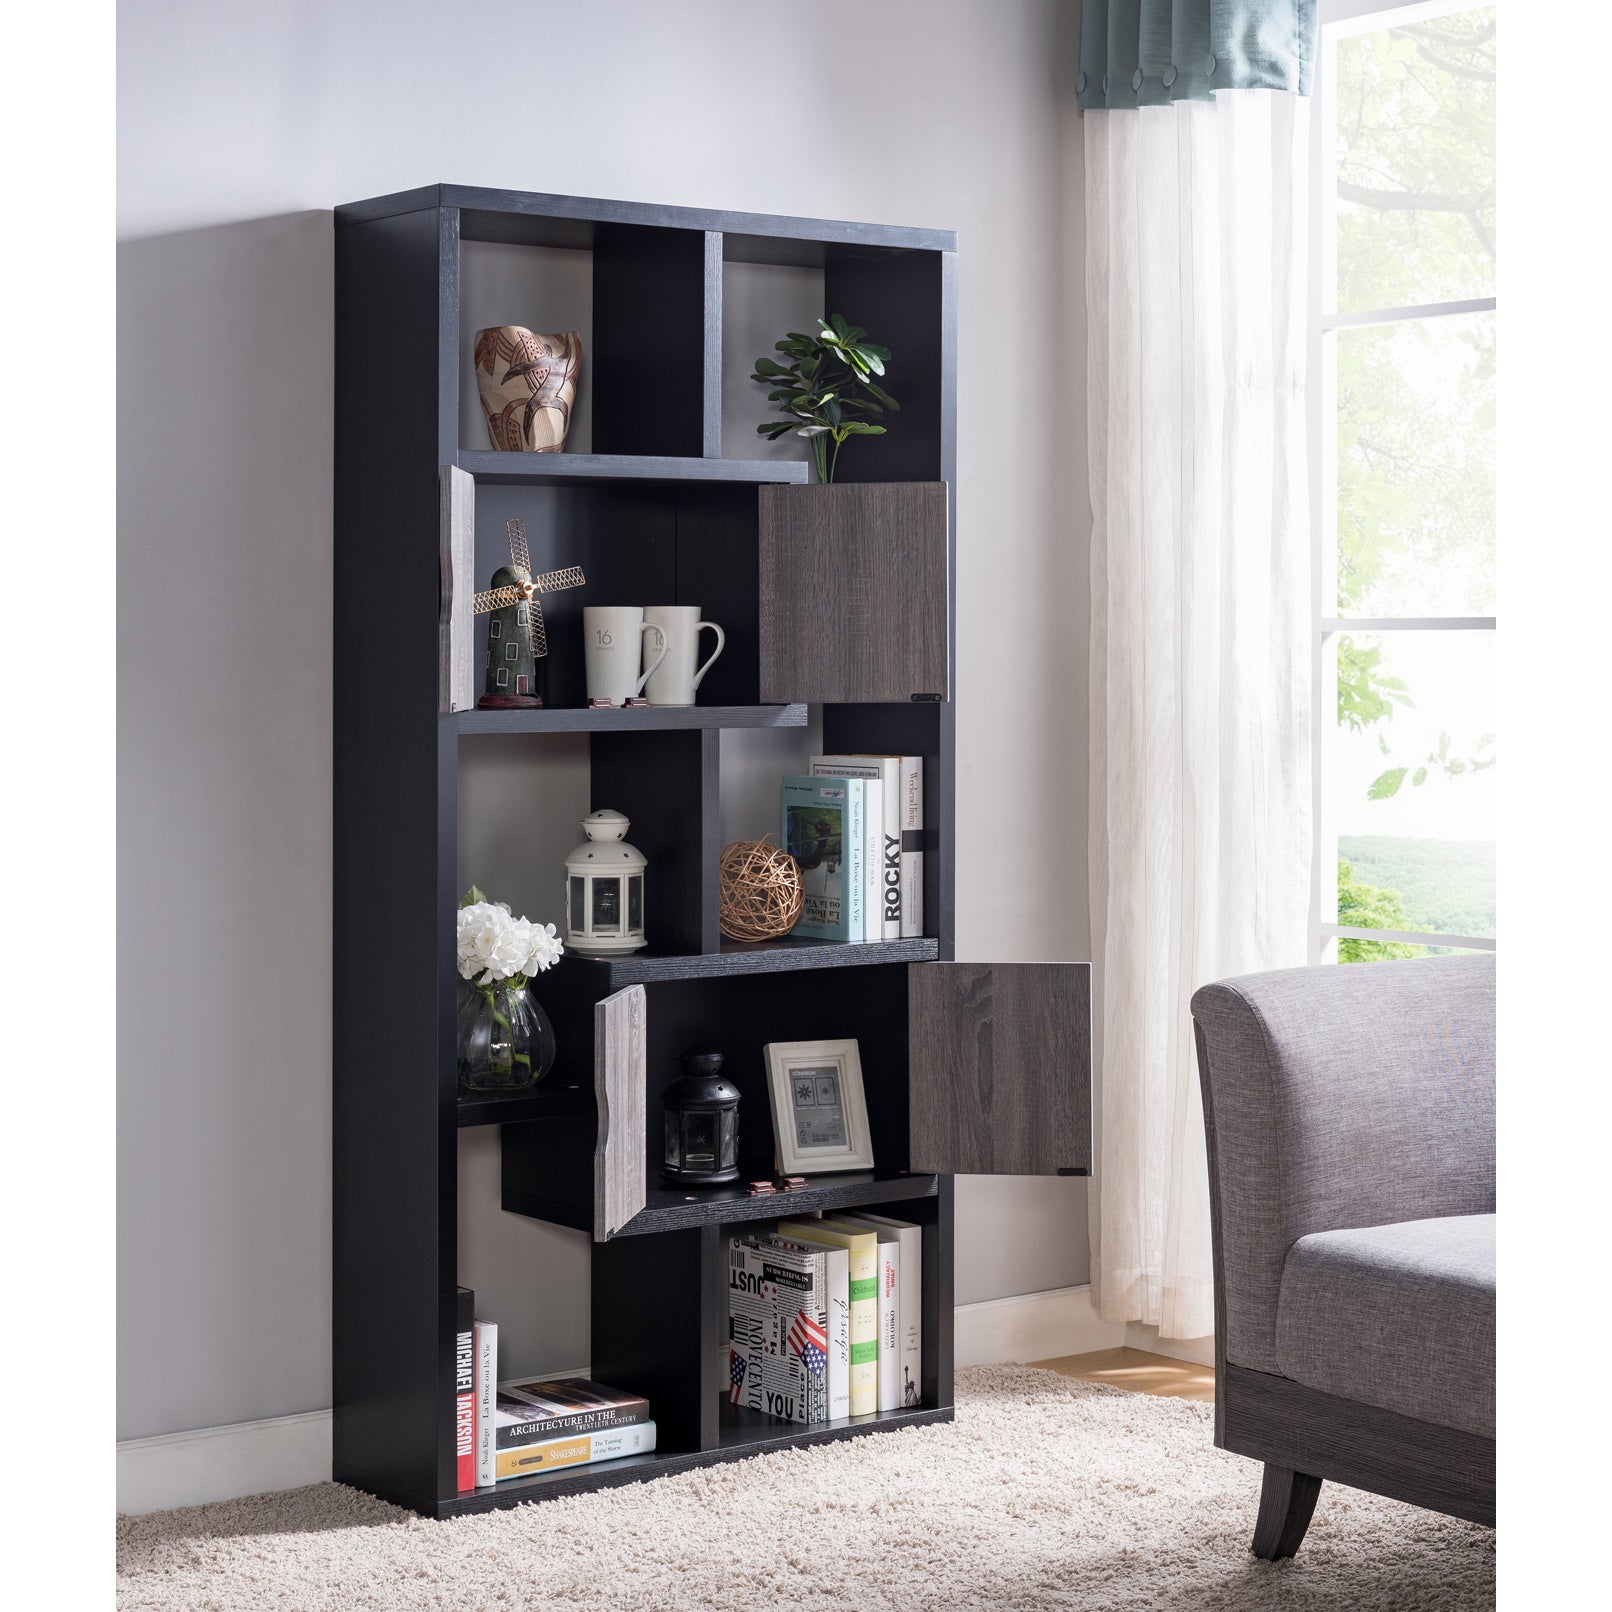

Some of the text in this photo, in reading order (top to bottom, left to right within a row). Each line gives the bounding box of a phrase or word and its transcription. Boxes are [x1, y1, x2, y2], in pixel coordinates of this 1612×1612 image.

[596, 629, 613, 645] 16
[907, 772, 919, 828] Weekend living
[853, 848, 860, 860] La
[884, 834, 900, 922] ROCKY
[854, 886, 860, 897] ou
[806, 908, 841, 920] La Boxe
[730, 1268, 765, 1295] JUST
[483, 1358, 490, 1368] la
[484, 1370, 490, 1381] ou
[457, 1331, 474, 1457] MICHAEL JACKSON
[482, 1383, 490, 1405] Boxe
[482, 1406, 489, 1419] La
[766, 1391, 793, 1419] YOU
[510, 1410, 616, 1437] ARCHITECYURE IN THE
[576, 1415, 637, 1432] TWENTIETH CENTURY
[550, 1446, 588, 1462] SHAKESPEARE
